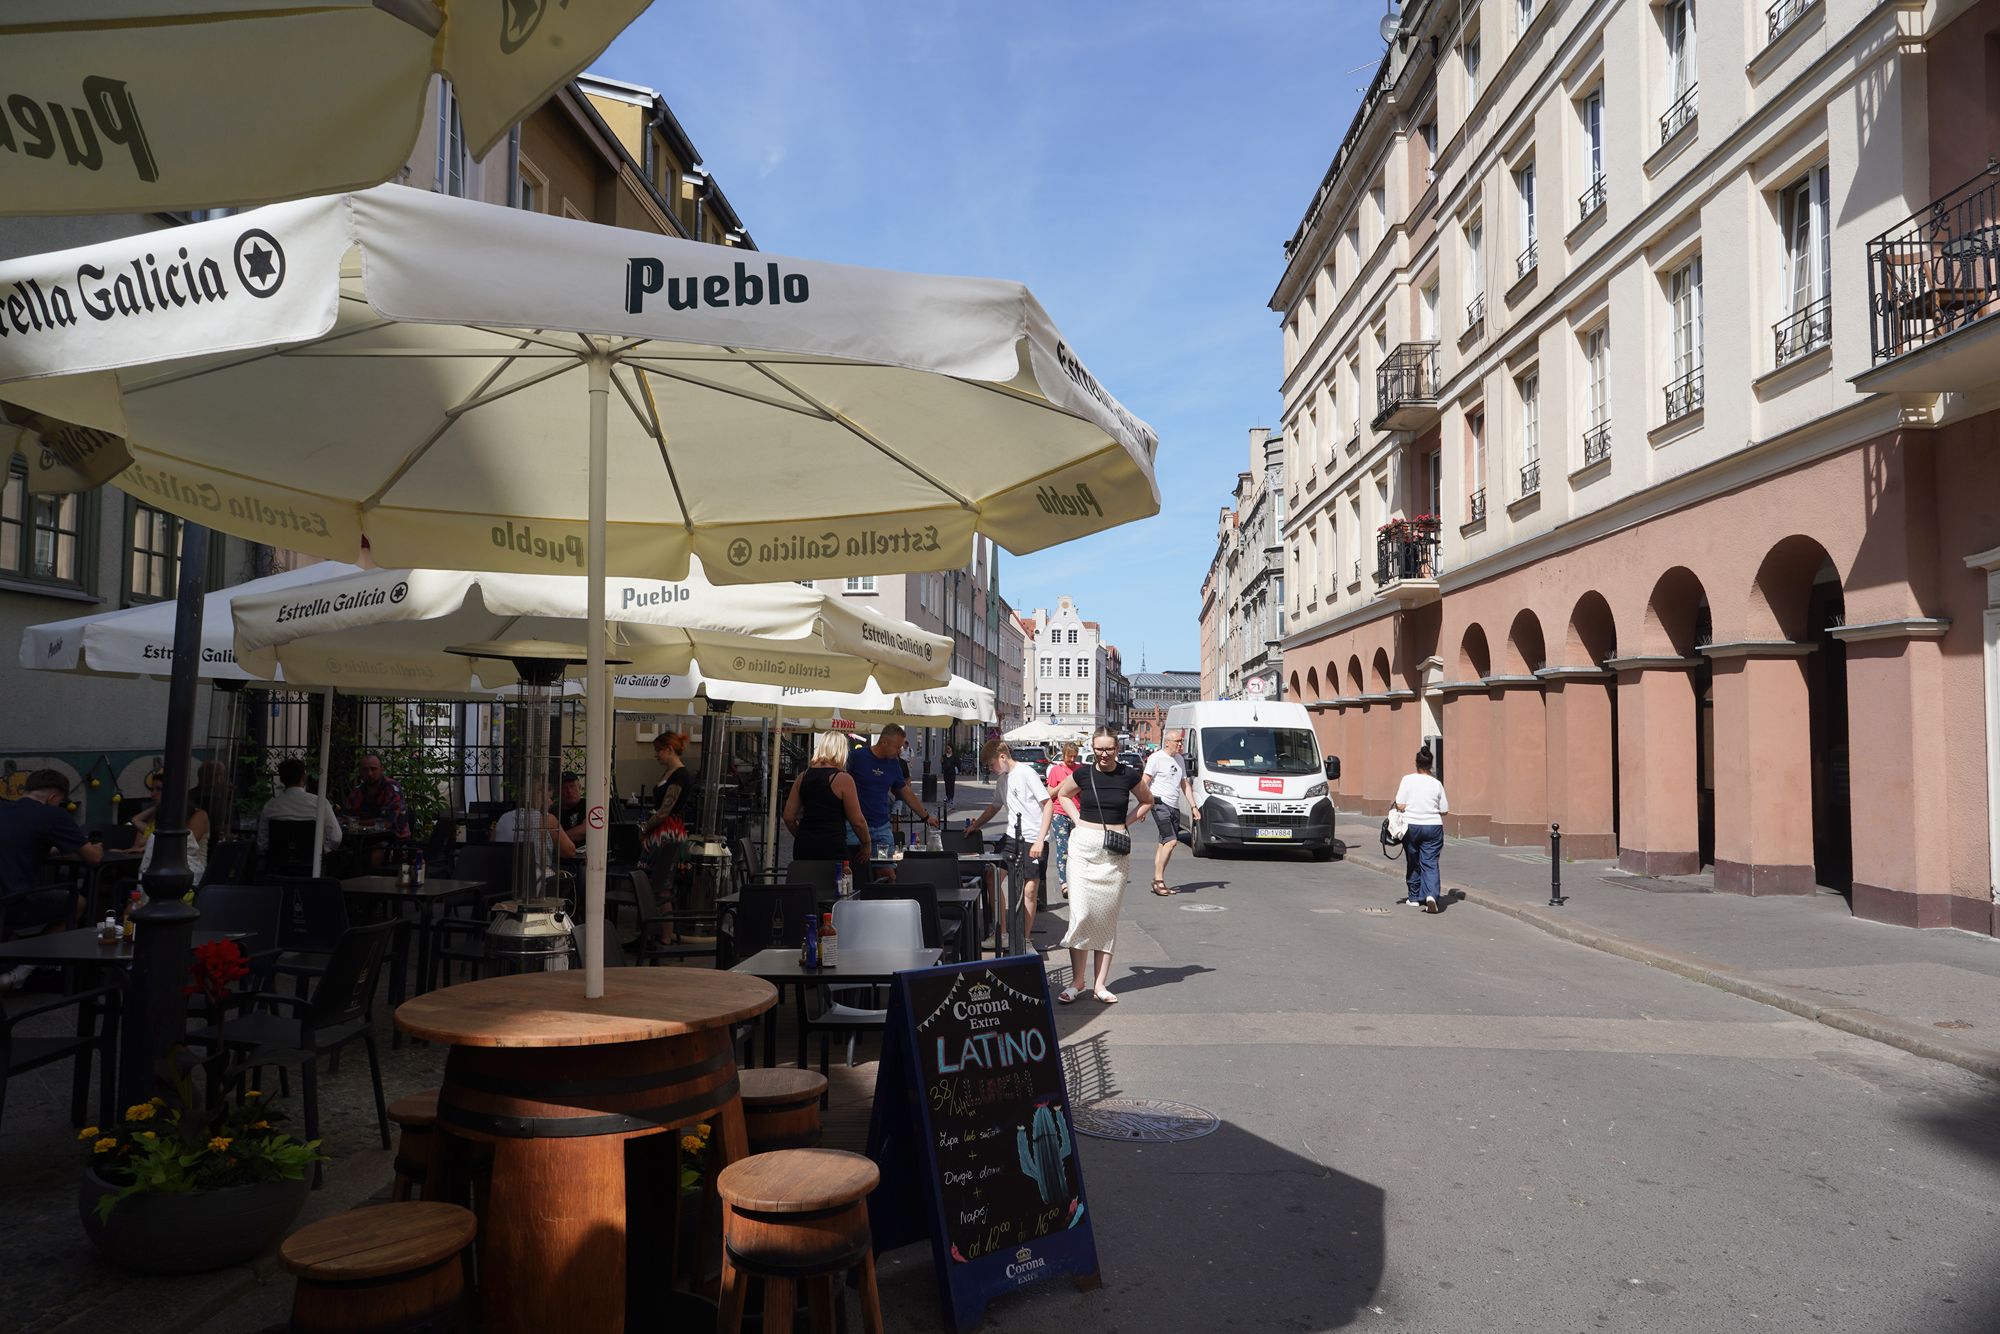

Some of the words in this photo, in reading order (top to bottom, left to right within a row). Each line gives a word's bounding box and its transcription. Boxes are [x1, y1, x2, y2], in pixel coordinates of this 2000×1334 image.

[77, 246, 229, 321] Galicia
[625, 257, 810, 314] Pueblo
[276, 598, 331, 623] Estrella
[333, 587, 386, 612] Galicia
[622, 584, 690, 610] Pueblo
[862, 622, 896, 649] Estrella
[896, 633, 924, 658] Galicia
[629, 675, 659, 687] Galicia
[1267, 803, 1281, 814] FIAT
[953, 999, 1010, 1021] Corona
[970, 1016, 1001, 1030] Extra
[936, 1027, 1047, 1074] LATINO
[1005, 1257, 1046, 1279] Corona
